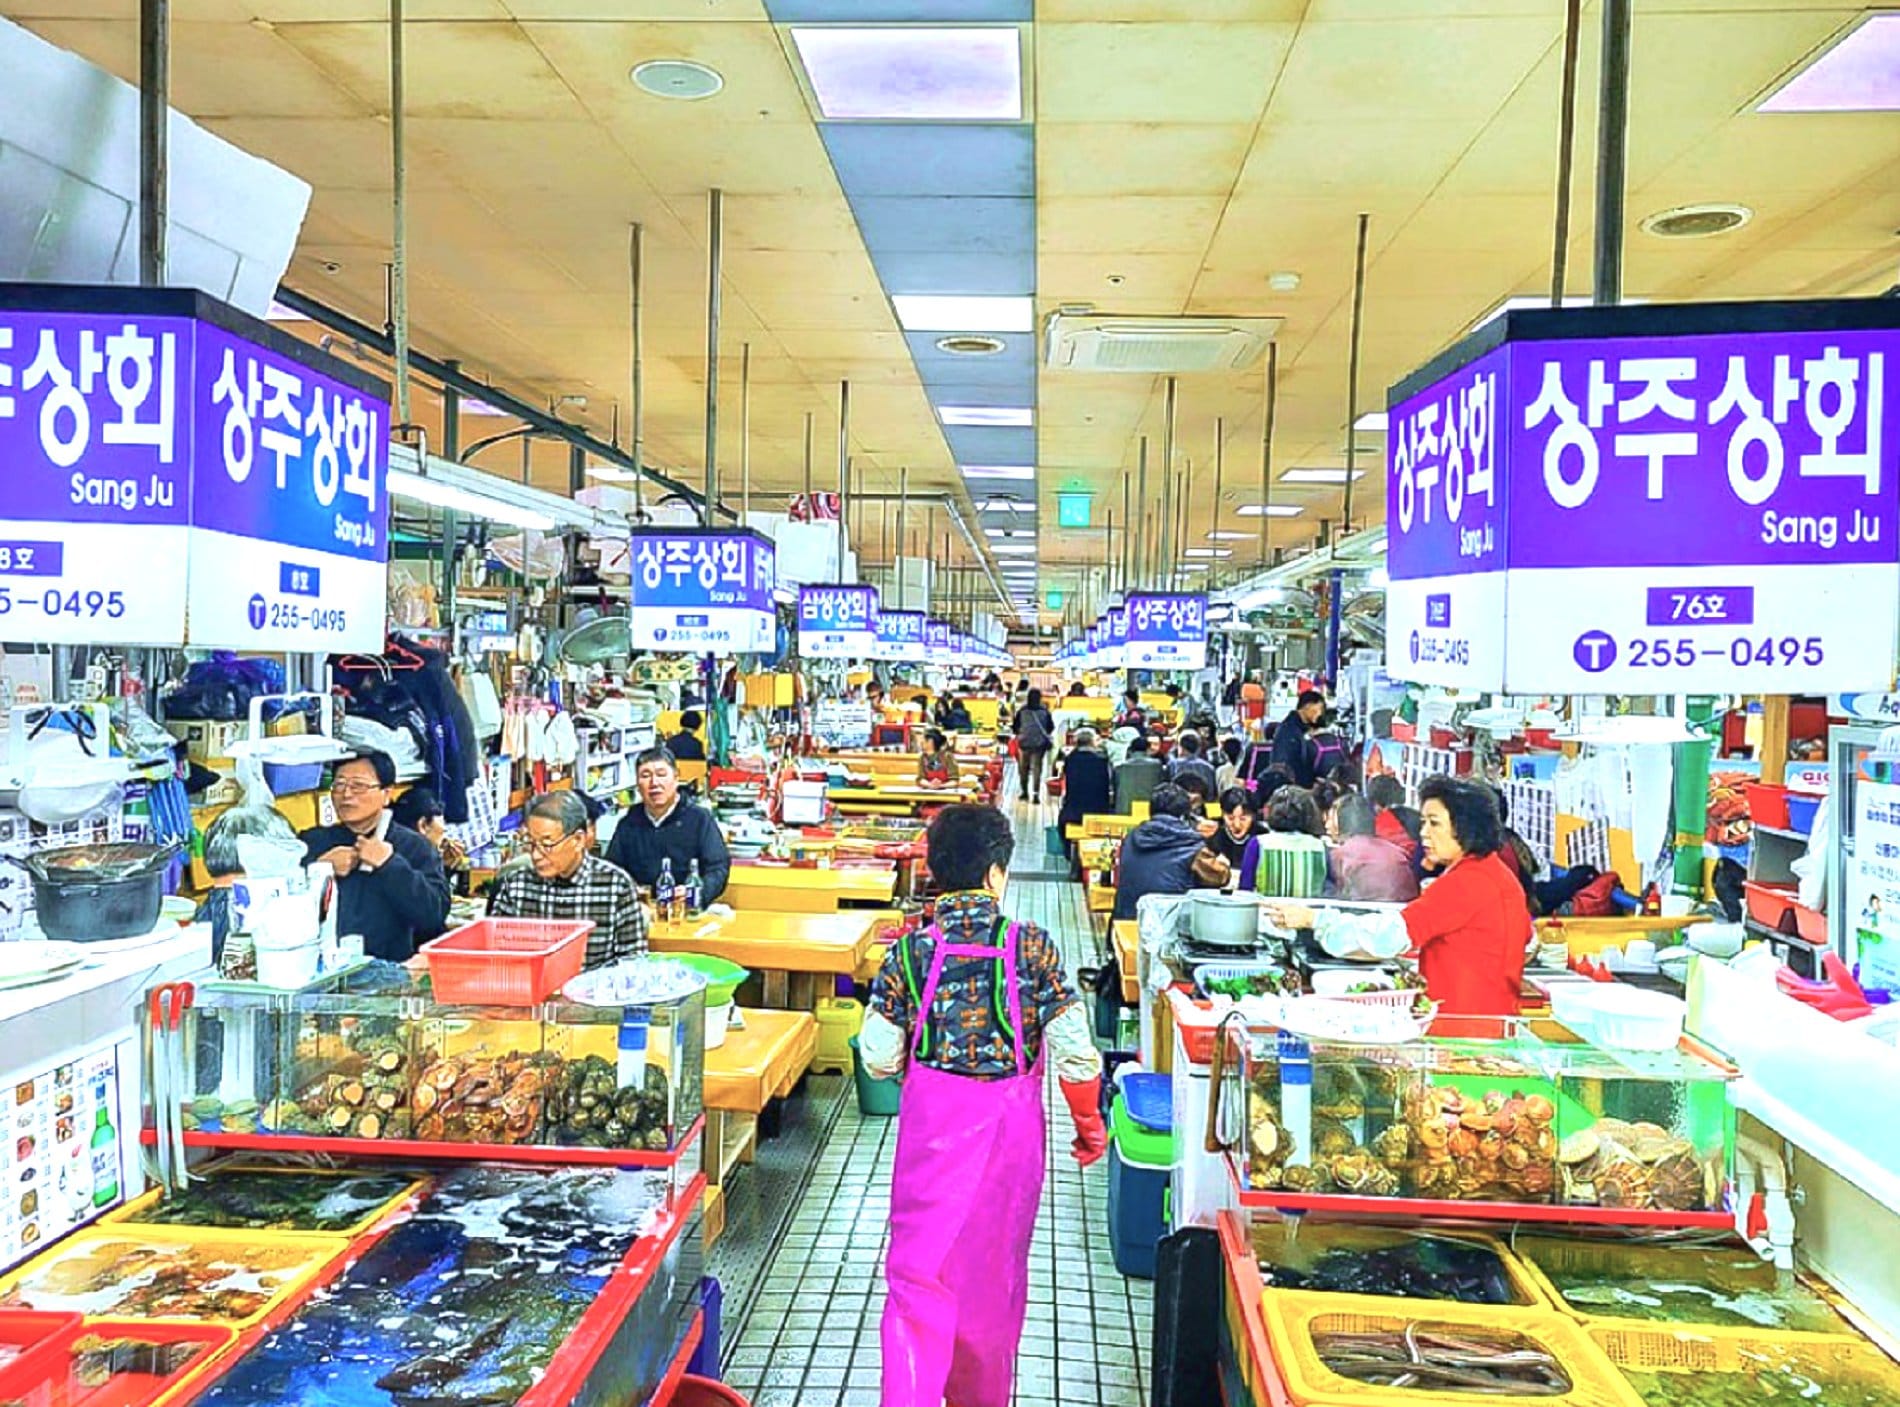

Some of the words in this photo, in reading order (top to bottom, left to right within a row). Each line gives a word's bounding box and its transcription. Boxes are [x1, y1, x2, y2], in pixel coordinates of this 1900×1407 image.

[0, 324, 176, 467] 상회
[212, 348, 377, 512] 상주상회
[1524, 346, 1885, 508] 상주상회
[1394, 371, 1496, 534] 상주상회
[70, 472, 138, 510] Sang
[143, 474, 174, 507] Ju
[334, 512, 361, 547] Sang
[362, 520, 376, 547] Ju
[1460, 526, 1482, 559] Sang
[1760, 511, 1839, 549] Sang
[1846, 510, 1880, 543] Ju
[638, 539, 747, 589] 상주상회
[271, 603, 345, 632] 255-0495
[1134, 599, 1203, 631] 상주상회
[1670, 596, 1728, 619] 76호
[671, 630, 730, 641] 255-0495
[1628, 637, 1824, 667] 255-0495
